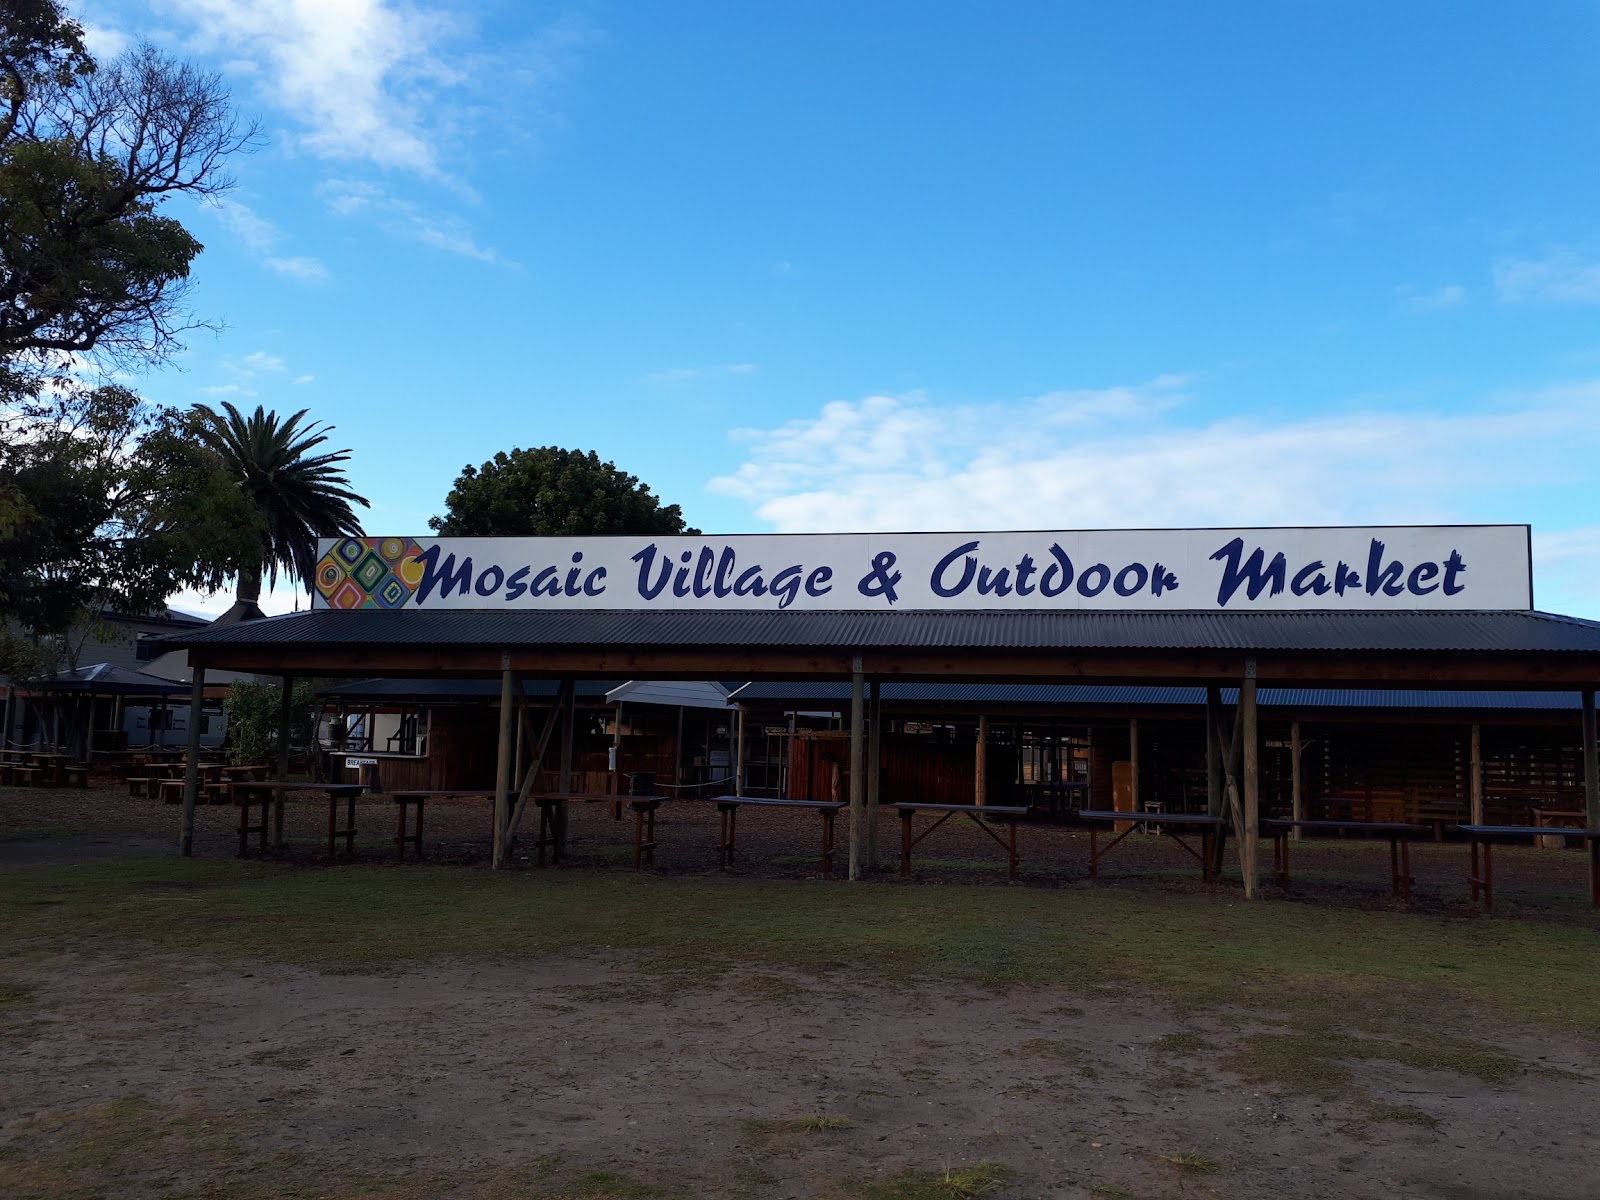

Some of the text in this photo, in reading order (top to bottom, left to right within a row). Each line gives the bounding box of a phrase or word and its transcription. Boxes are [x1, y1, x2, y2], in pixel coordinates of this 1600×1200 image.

[414, 537, 1467, 609] Mosaic Village & Outdoor Market
